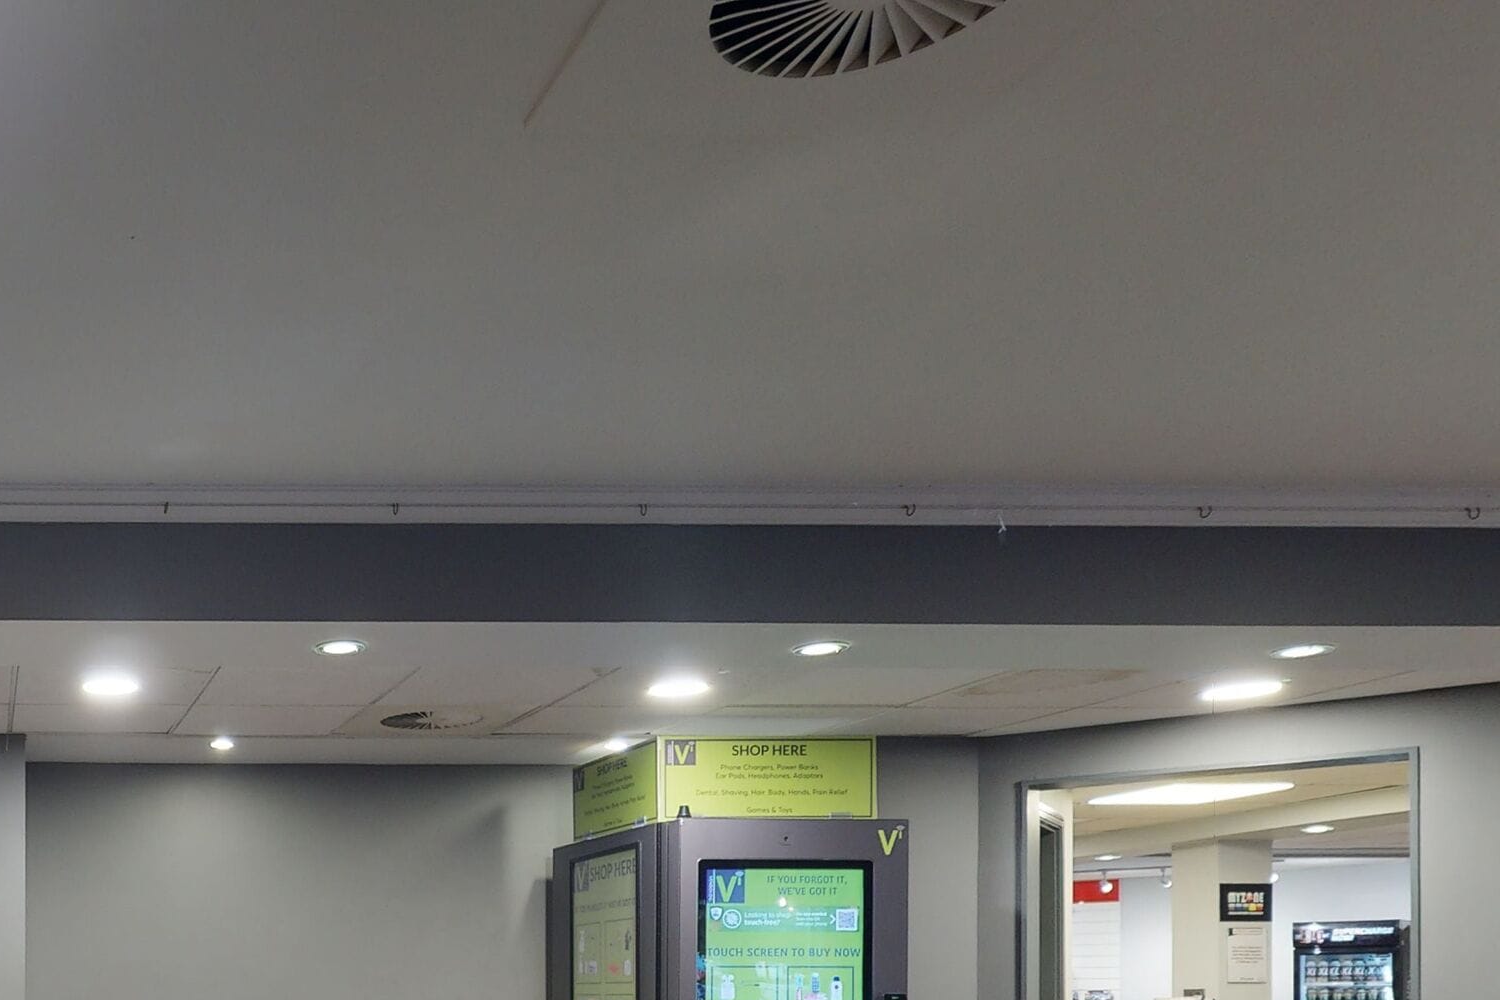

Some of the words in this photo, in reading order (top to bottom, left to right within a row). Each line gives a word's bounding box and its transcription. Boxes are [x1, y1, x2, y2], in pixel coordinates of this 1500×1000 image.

[731, 744, 769, 757] SHOP
[772, 744, 808, 757] HERE
[778, 806, 793, 814] Toys
[590, 863, 613, 882] SHOP
[767, 875, 775, 884] IF
[777, 875, 798, 884] YOU
[799, 875, 834, 884] FORGOT
[836, 875, 848, 886] IT,
[777, 887, 806, 896] WE'VE
[808, 887, 827, 896] GOT
[829, 887, 838, 896] IT
[707, 947, 744, 957] TOUCH
[747, 947, 788, 957] SCREEN
[792, 947, 805, 957] TO
[808, 947, 831, 957] BUY
[834, 947, 861, 957] NOW
